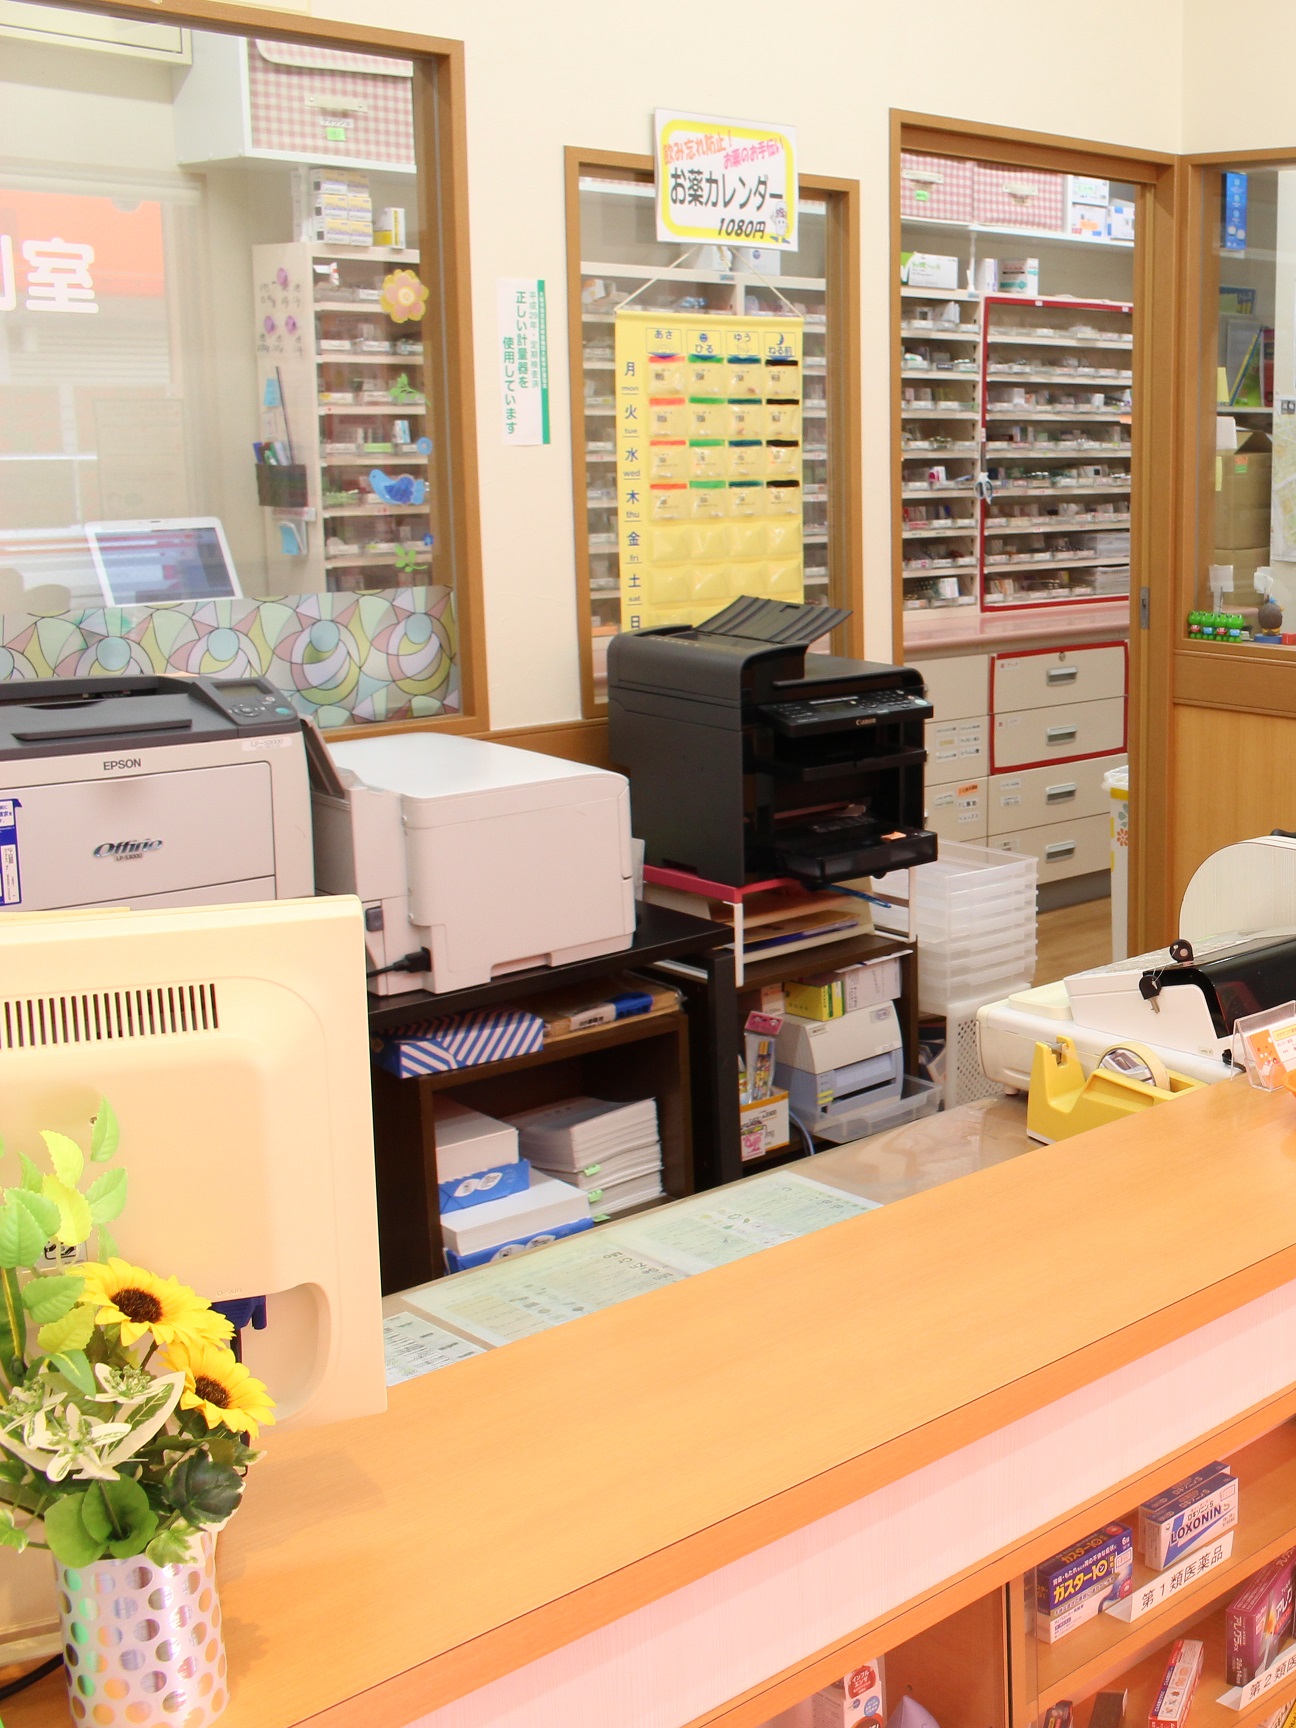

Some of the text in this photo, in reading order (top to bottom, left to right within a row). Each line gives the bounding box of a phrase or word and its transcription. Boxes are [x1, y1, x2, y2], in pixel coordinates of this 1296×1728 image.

[664, 130, 732, 165] 飲み忘れ防止！
[670, 167, 783, 212] お薬カレンダー
[718, 218, 766, 239] 1080円
[516, 291, 528, 388] 正しい計量器を
[654, 330, 673, 339] あさ
[734, 333, 751, 343] ゆう
[695, 344, 714, 354] ひる
[768, 346, 793, 356] ねる前
[624, 361, 636, 376] 月
[502, 337, 517, 434] 使用しています
[624, 405, 637, 420] 火
[625, 448, 638, 462] 水
[623, 470, 641, 478] wed
[626, 490, 640, 504] 木
[626, 511, 640, 519] thu
[627, 531, 641, 546] 金
[628, 575, 641, 588] 土
[630, 615, 641, 629] 日
[856, 718, 877, 726] Canon
[103, 758, 142, 771] EPSON
[1170, 1504, 1221, 1543] LOXONIN
[1141, 1545, 1223, 1611] 第1類医薬品
